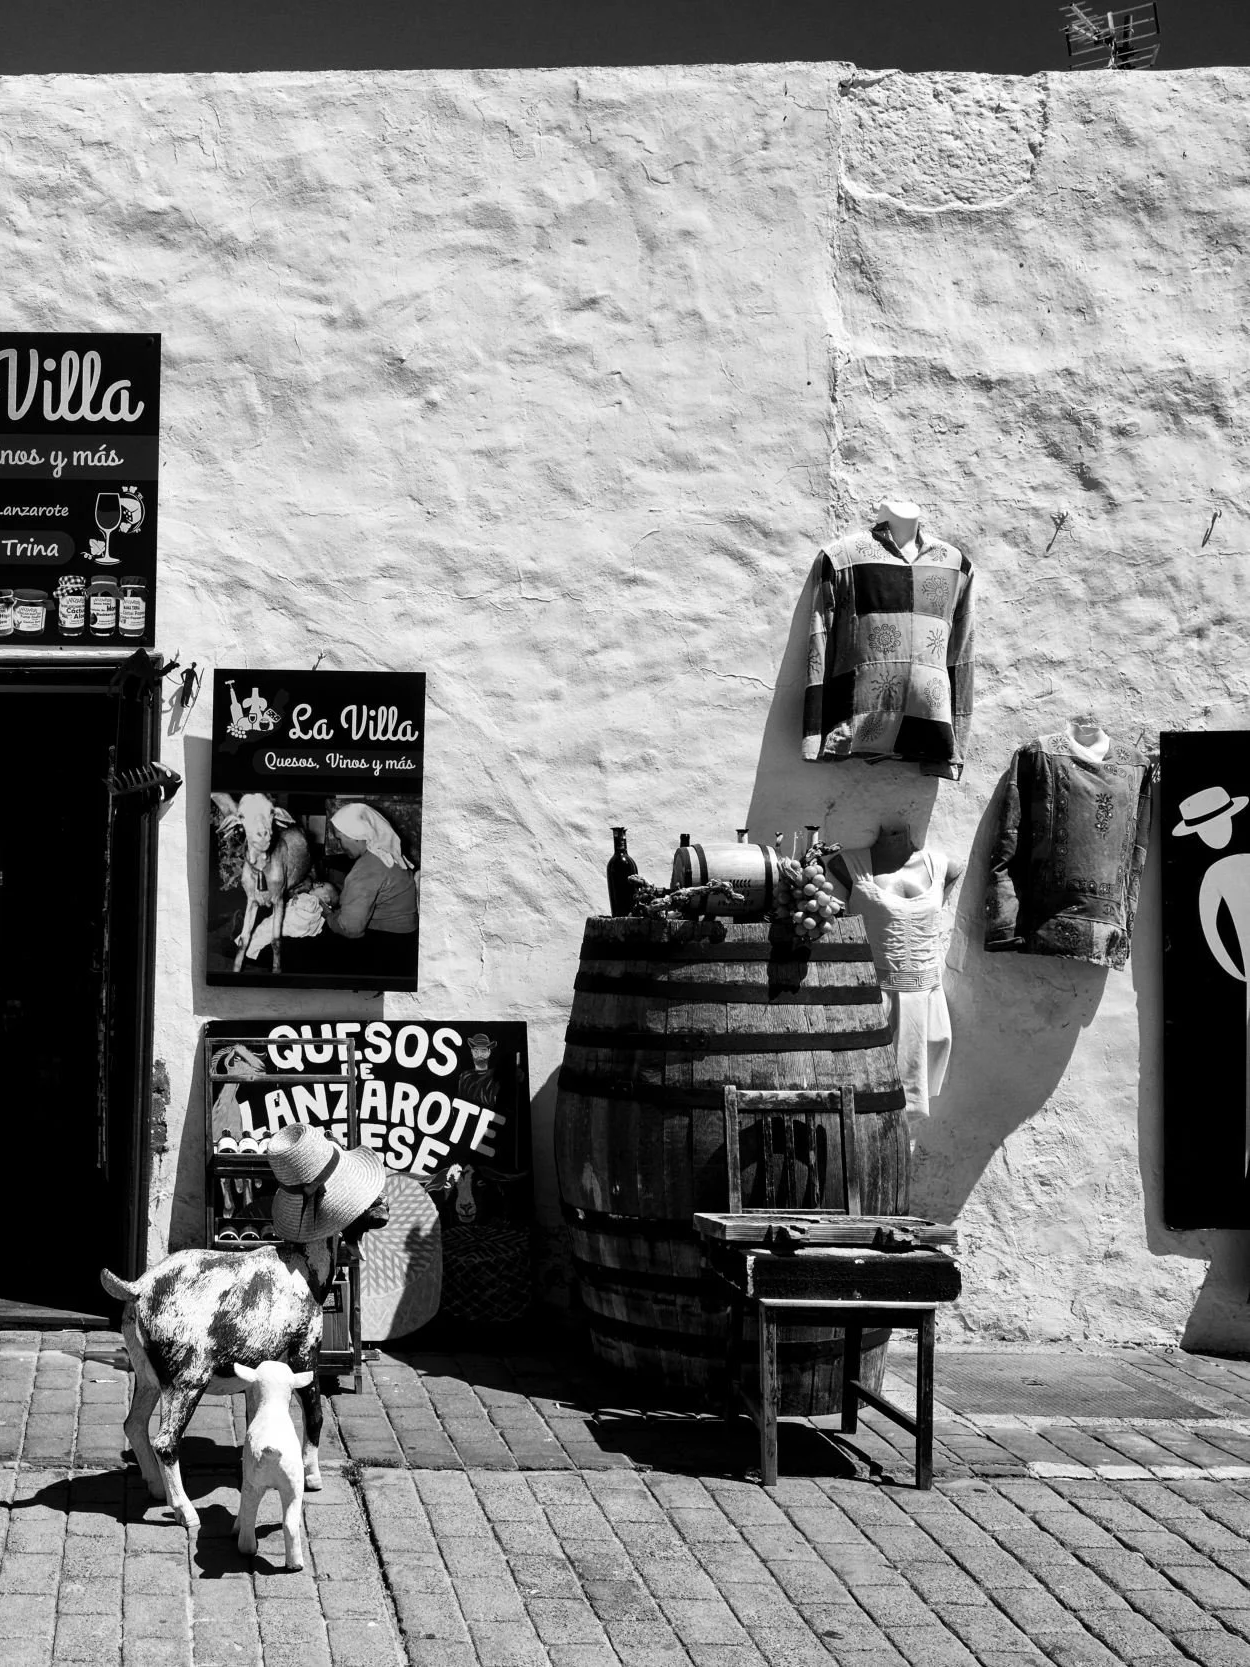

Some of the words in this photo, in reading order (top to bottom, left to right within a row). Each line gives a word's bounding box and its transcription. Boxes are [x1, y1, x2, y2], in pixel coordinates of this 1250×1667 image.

[49, 450, 68, 479] y
[72, 443, 125, 467] más
[1, 537, 59, 557] Trina
[288, 703, 335, 740] La
[340, 704, 419, 742] Villa
[264, 751, 320, 771] Quesos,
[325, 752, 370, 769] Vinos
[372, 759, 384, 777] y
[385, 755, 417, 770] más
[267, 1021, 463, 1077] QUESOS
[239, 1080, 506, 1157] LANZAROTE
[316, 1123, 450, 1175] ESE
